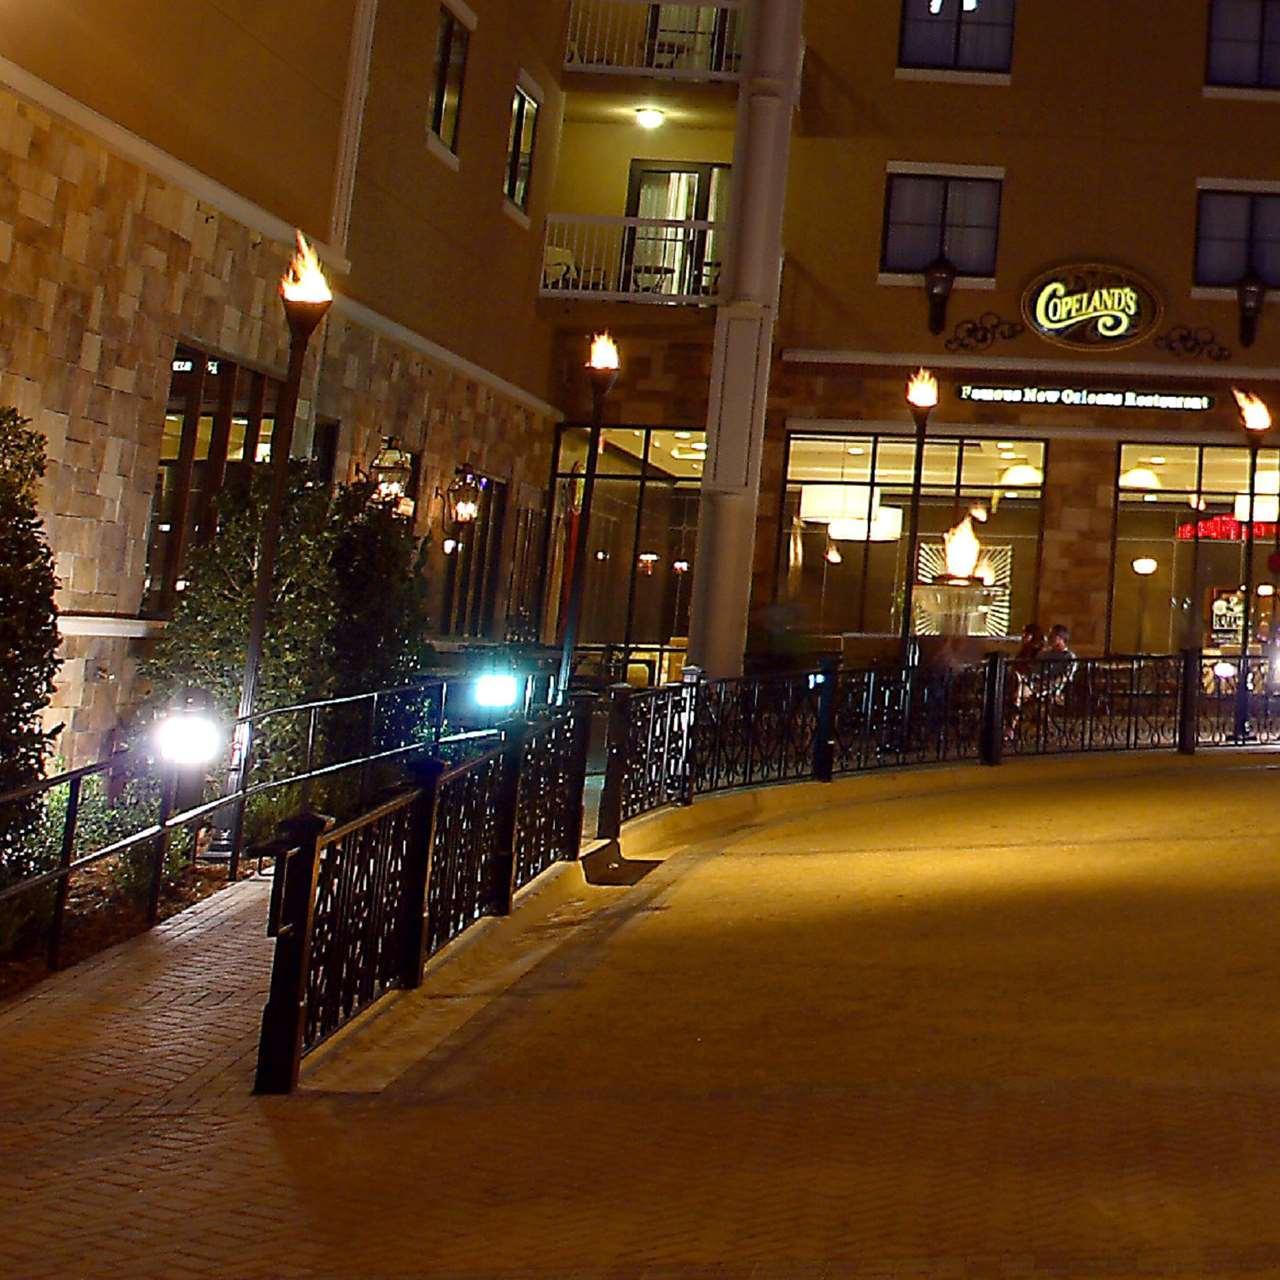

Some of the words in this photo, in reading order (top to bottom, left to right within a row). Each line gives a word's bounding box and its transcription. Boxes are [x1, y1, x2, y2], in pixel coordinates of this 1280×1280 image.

[961, 386, 1022, 401] Famous
[1023, 388, 1060, 403] New
[1061, 389, 1123, 406] Orleans
[1124, 391, 1209, 409] Restaurant
